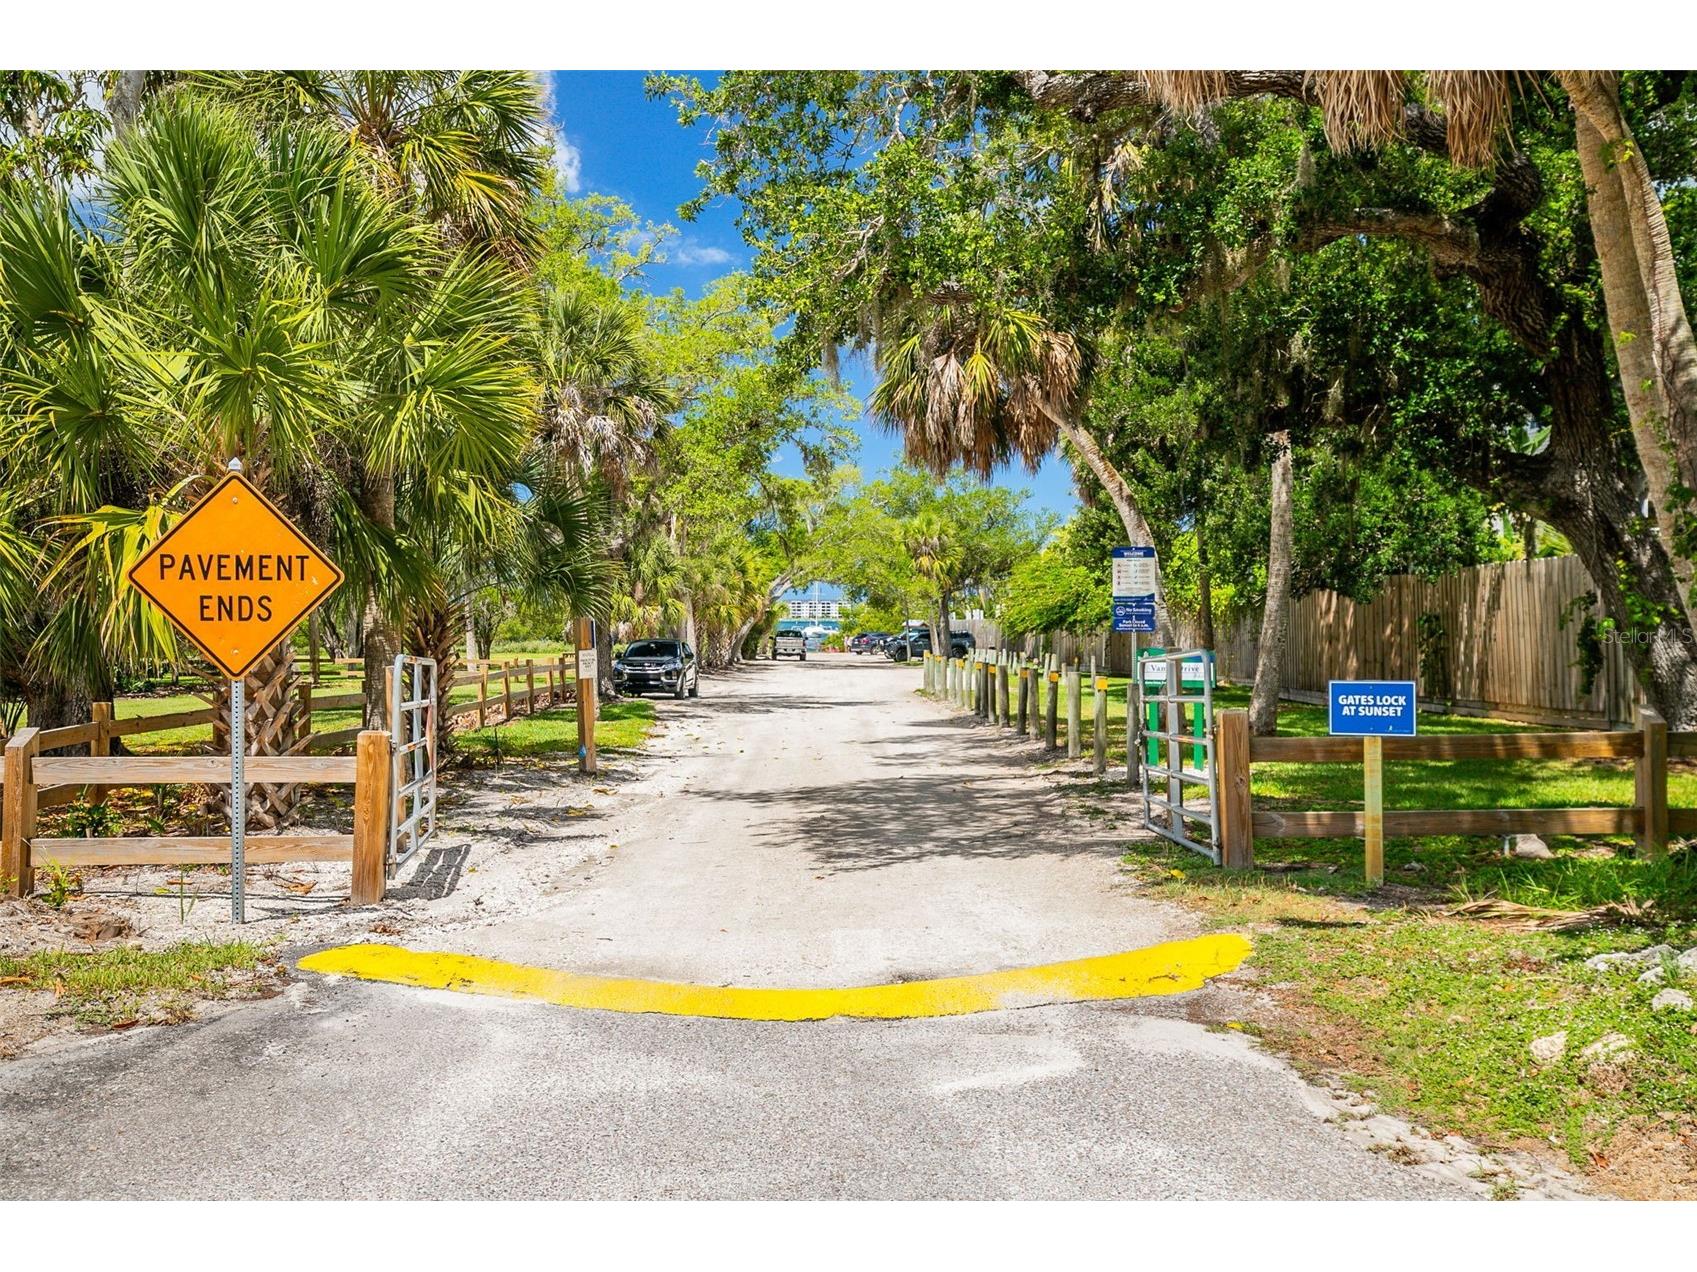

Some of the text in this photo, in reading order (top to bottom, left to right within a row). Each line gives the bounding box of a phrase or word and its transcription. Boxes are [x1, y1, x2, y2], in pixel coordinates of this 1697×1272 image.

[159, 553, 310, 581] PAVEMENT
[199, 595, 273, 622] ENDS
[1338, 694, 1407, 706] GATES LOCK
[1342, 705, 1403, 717] AT SUNSET
